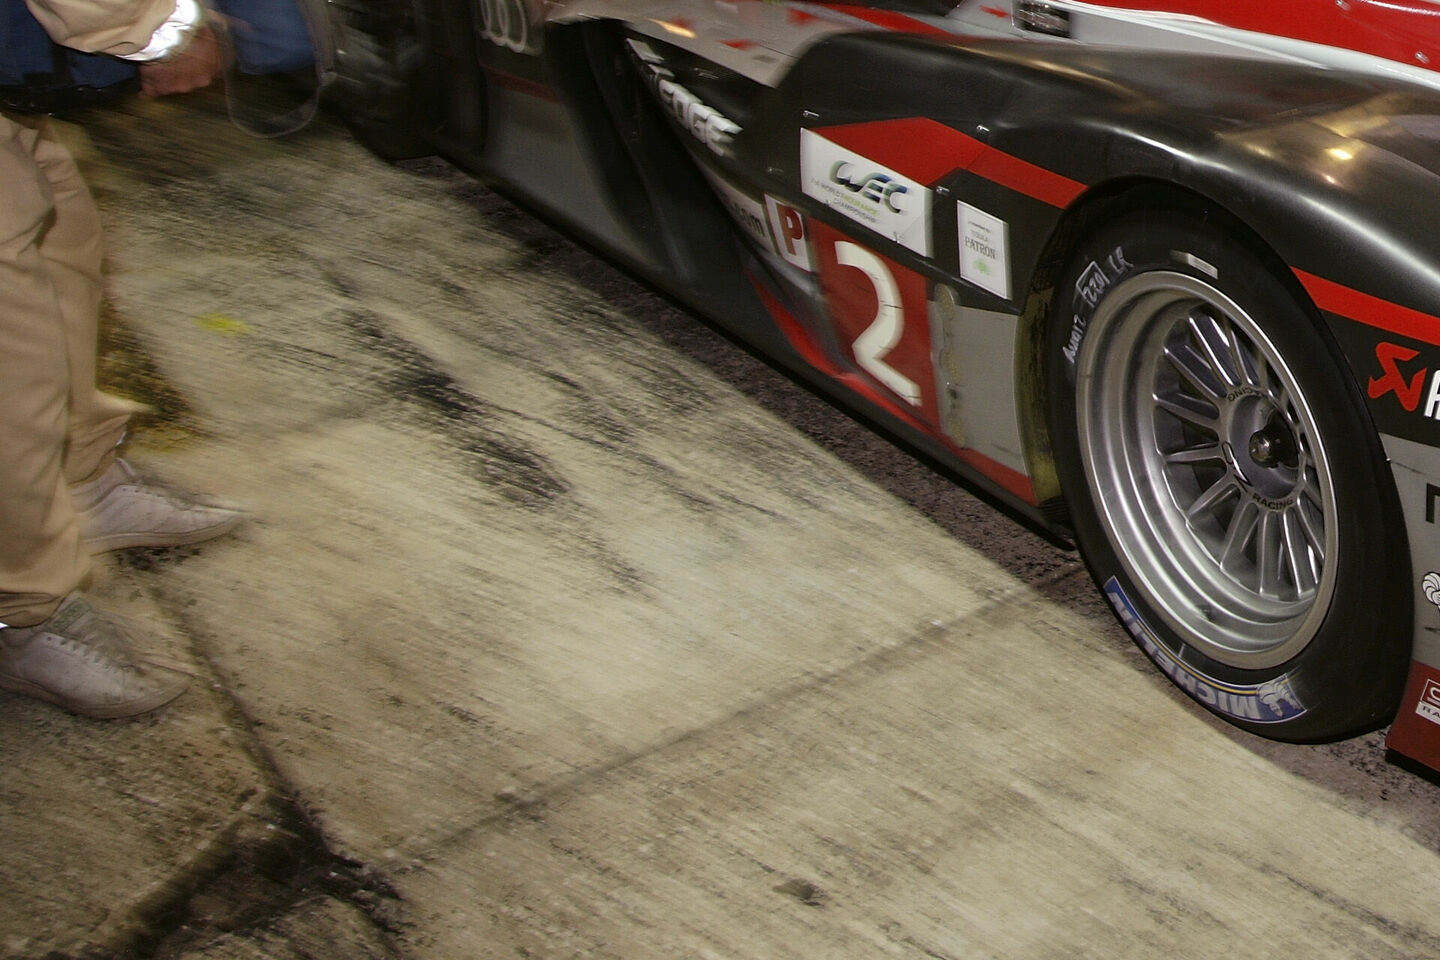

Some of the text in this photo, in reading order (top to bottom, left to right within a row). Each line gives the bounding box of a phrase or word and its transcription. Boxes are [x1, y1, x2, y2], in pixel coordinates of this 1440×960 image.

[829, 159, 908, 214] WEC
[834, 240, 923, 408] 2
[1253, 492, 1294, 510] RACING
